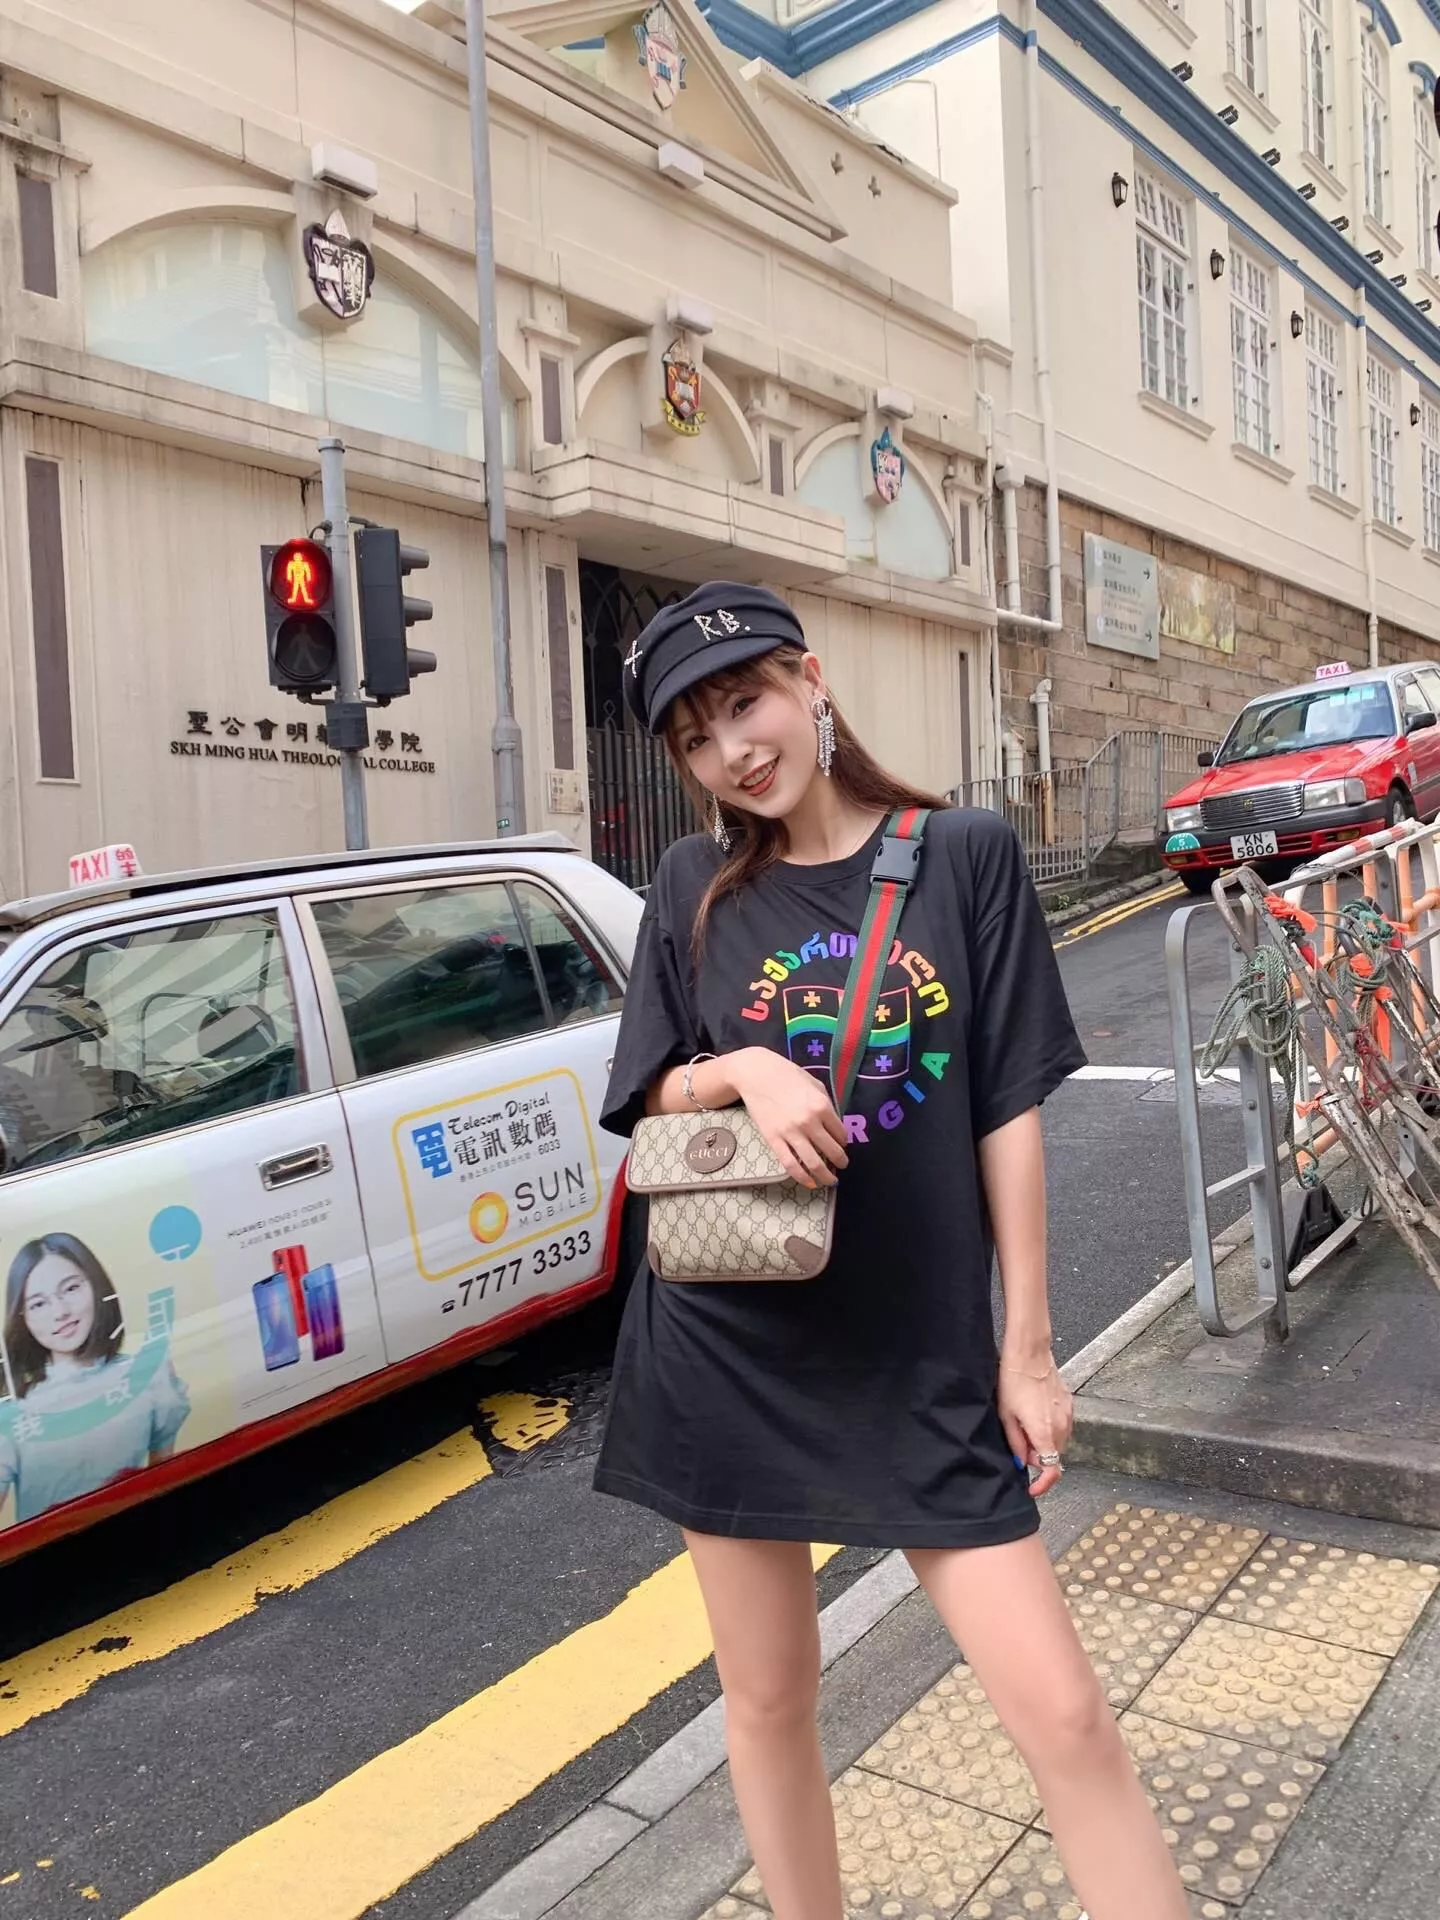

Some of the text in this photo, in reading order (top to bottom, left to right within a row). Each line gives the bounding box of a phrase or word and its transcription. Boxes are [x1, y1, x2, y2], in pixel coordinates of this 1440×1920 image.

[1318, 665, 1345, 677] TAXI
[187, 710, 423, 753] 聖公會明學院
[171, 740, 202, 756] SKH
[205, 743, 246, 761] MING
[248, 747, 278, 762] HUA
[379, 758, 436, 774] COLLEGE
[1237, 843, 1274, 858] 5806
[1243, 833, 1264, 847] KN
[70, 851, 110, 884] TAXI
[447, 1091, 551, 1136] Telecom Digital
[842, 1052, 951, 1144] RGIA
[453, 1110, 558, 1166] 電訊數碼
[537, 1139, 562, 1156] 6033
[514, 1162, 585, 1211] SUN
[518, 1192, 588, 1228] MOBILE
[458, 1230, 592, 1307] 7777 3333
